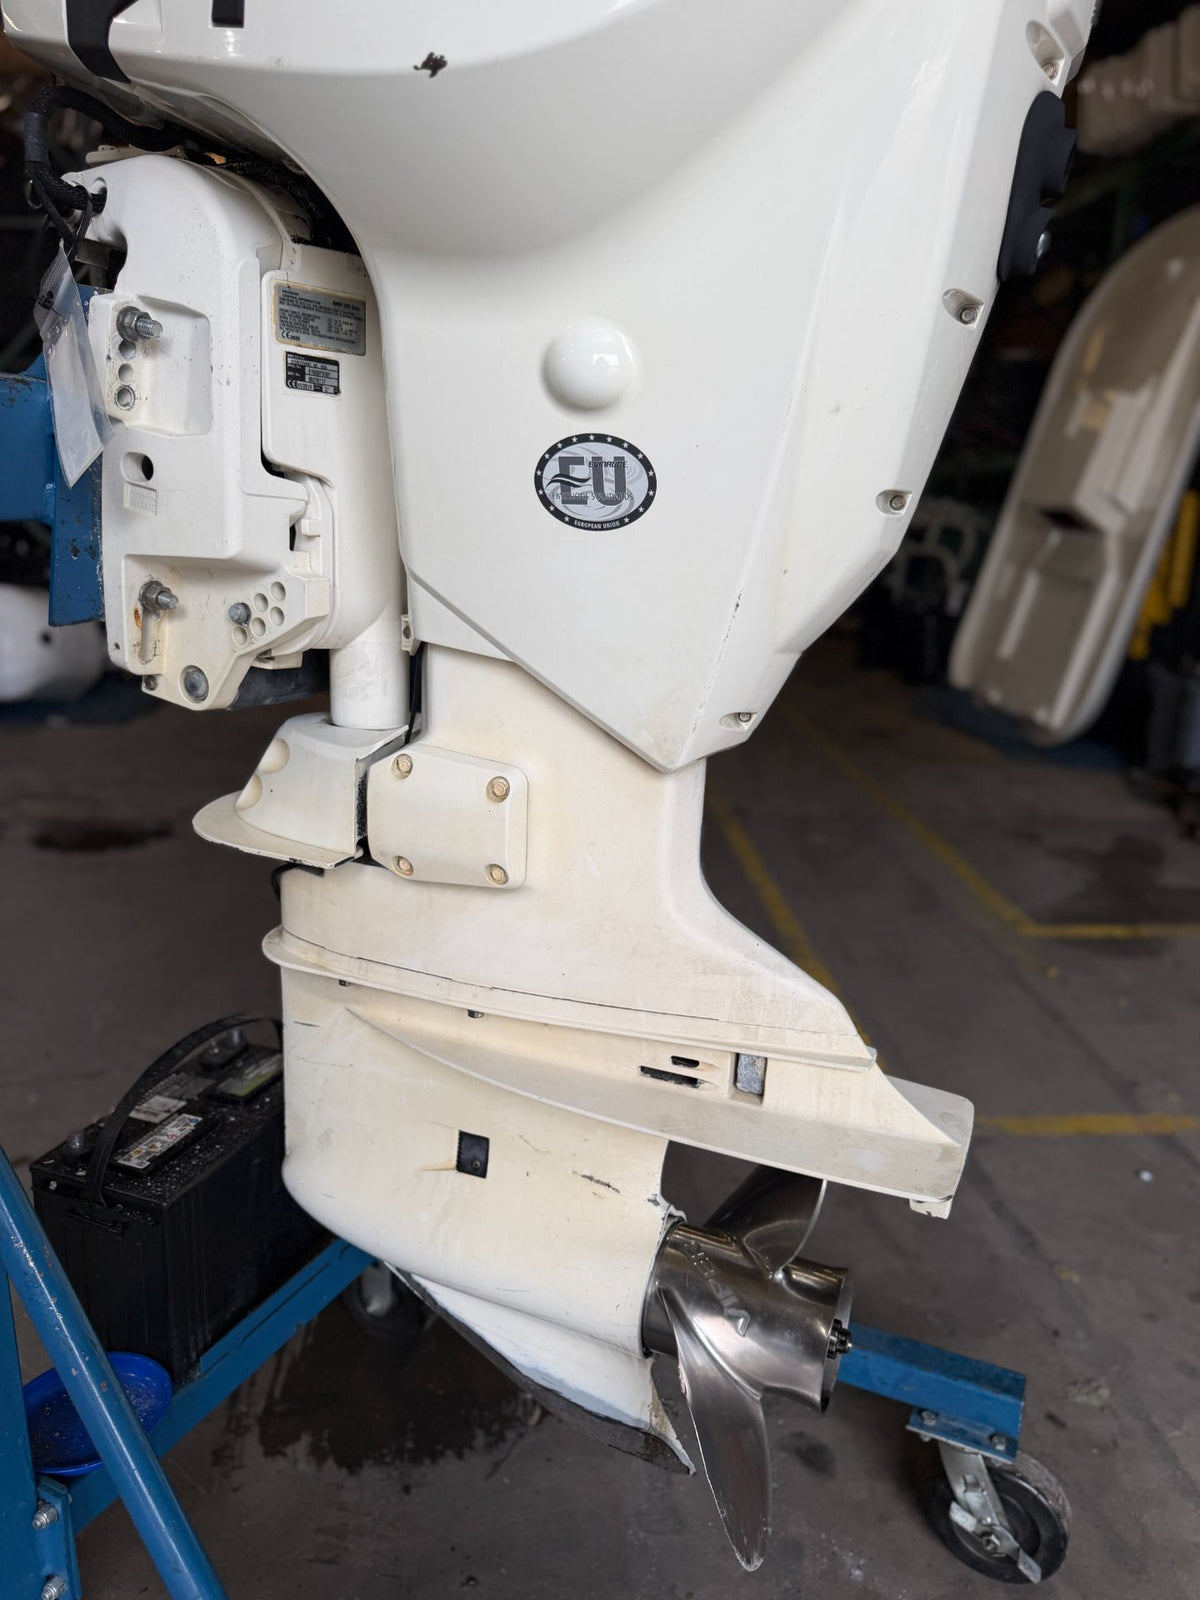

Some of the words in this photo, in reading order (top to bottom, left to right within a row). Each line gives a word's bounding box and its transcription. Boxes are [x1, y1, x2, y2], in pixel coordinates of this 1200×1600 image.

[558, 456, 627, 506] EU
[574, 520, 601, 529] EUROPEAN
[602, 520, 620, 529] UNION
